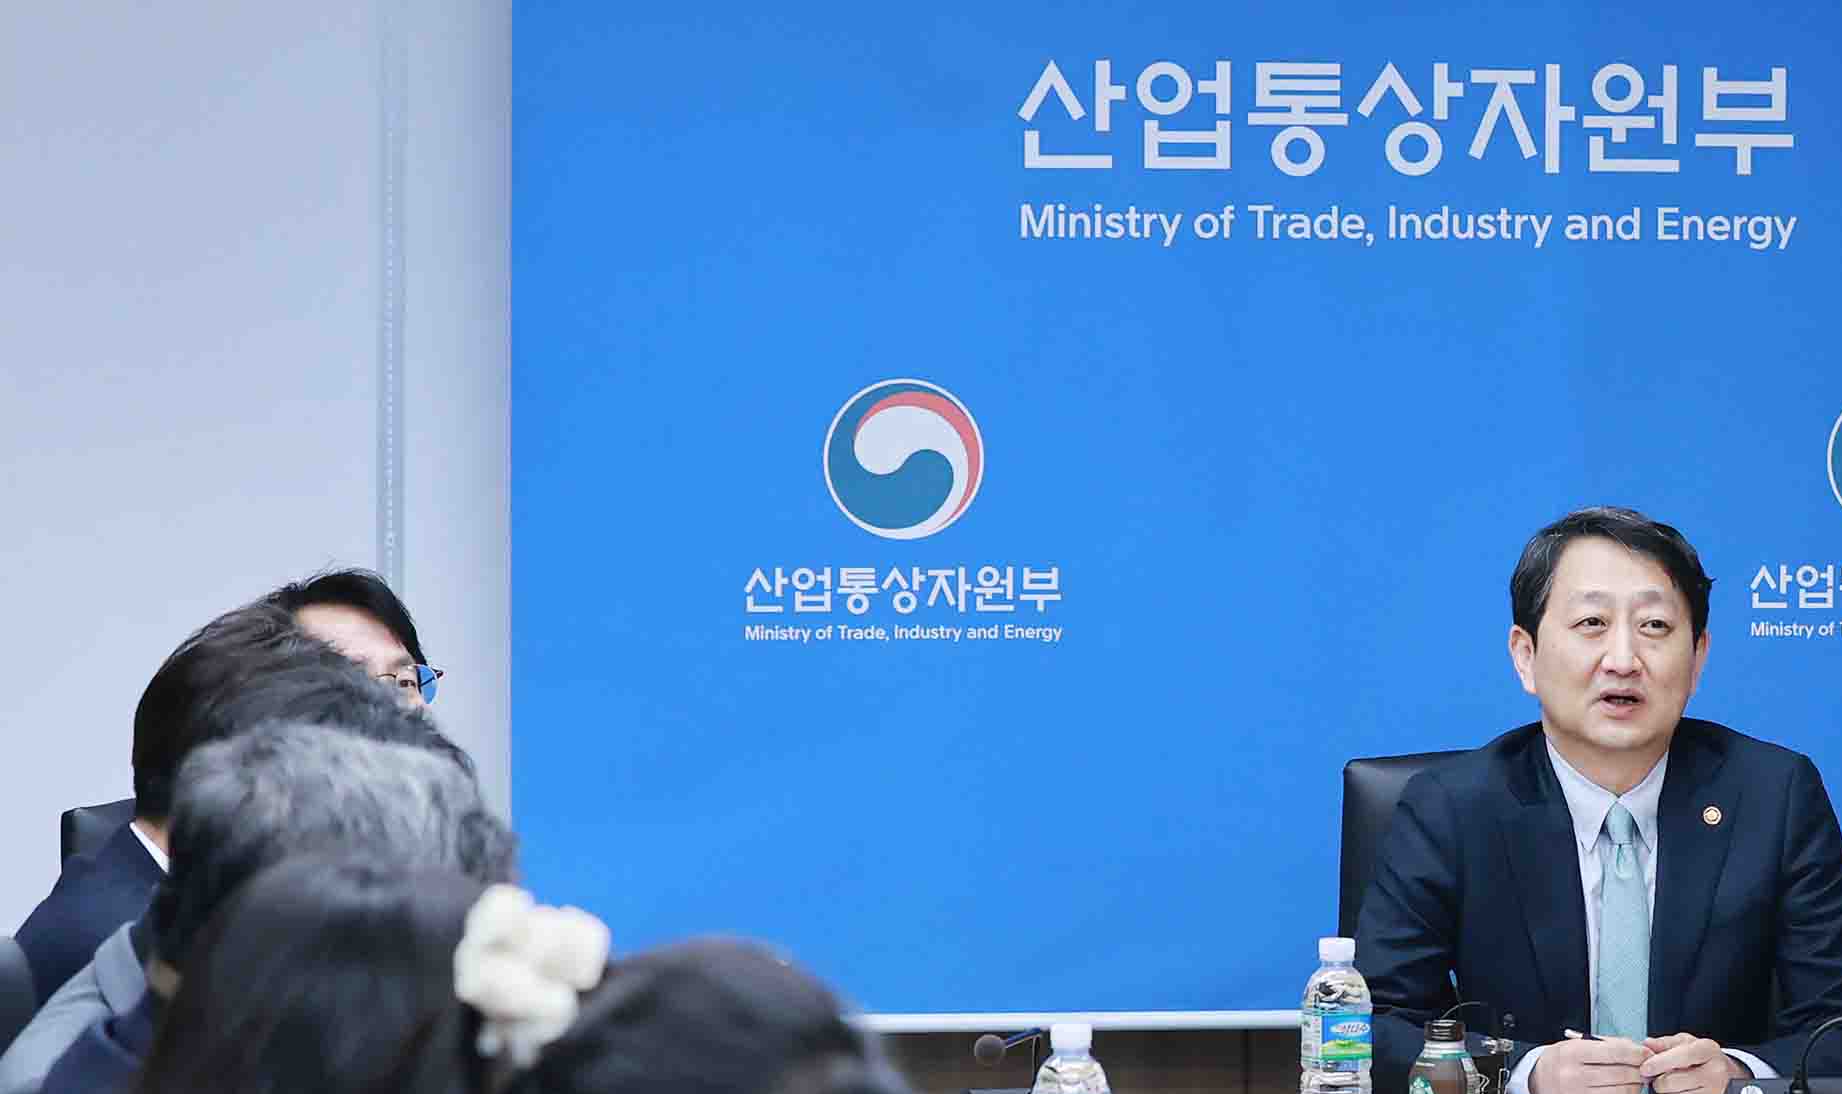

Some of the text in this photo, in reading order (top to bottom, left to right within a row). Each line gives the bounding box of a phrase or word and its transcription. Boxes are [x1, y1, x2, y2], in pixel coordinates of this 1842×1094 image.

[1018, 60, 1794, 176] 산업통상자원부
[1020, 204, 1797, 250] Ministry of Trade, Industry and Energy
[744, 565, 1062, 615] 산업통상자원부
[744, 624, 1063, 644] Ministry of Trade, Industry and Energy
[1750, 621, 1814, 639] Ministry
[1818, 621, 1835, 637] of
